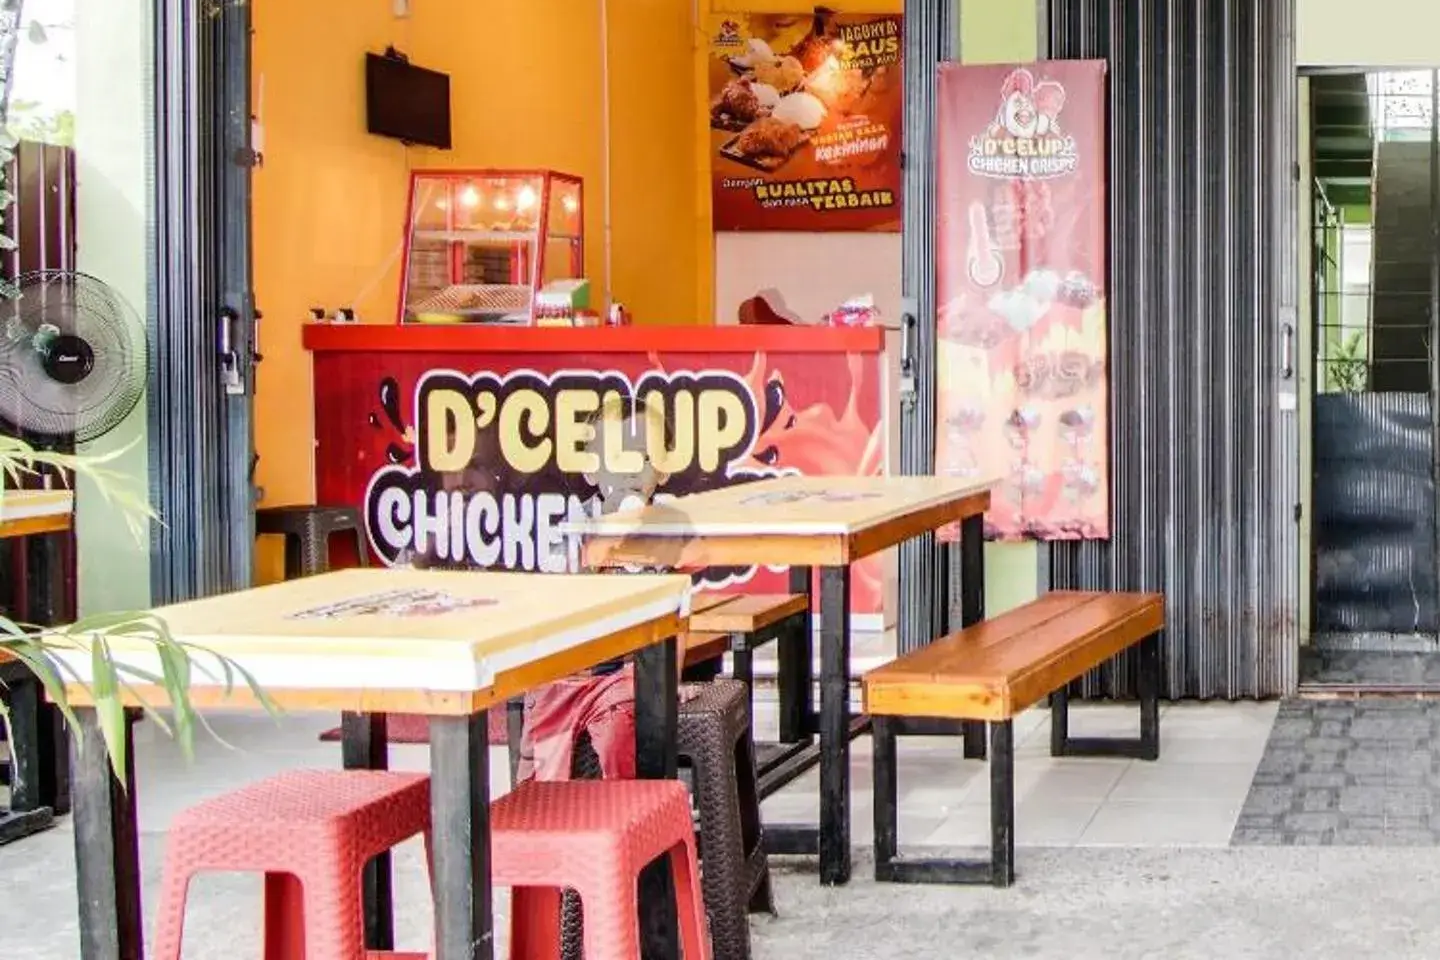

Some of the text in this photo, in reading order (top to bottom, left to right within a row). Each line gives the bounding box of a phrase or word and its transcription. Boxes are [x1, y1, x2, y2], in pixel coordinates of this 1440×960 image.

[842, 36, 898, 60] SAUS
[984, 138, 1063, 157] D'CELUP
[971, 156, 1076, 174] CHICKEN CRISPY
[756, 179, 853, 199] KUALITAS
[811, 192, 893, 209] TERBAIK
[427, 388, 745, 473] D'CELUP
